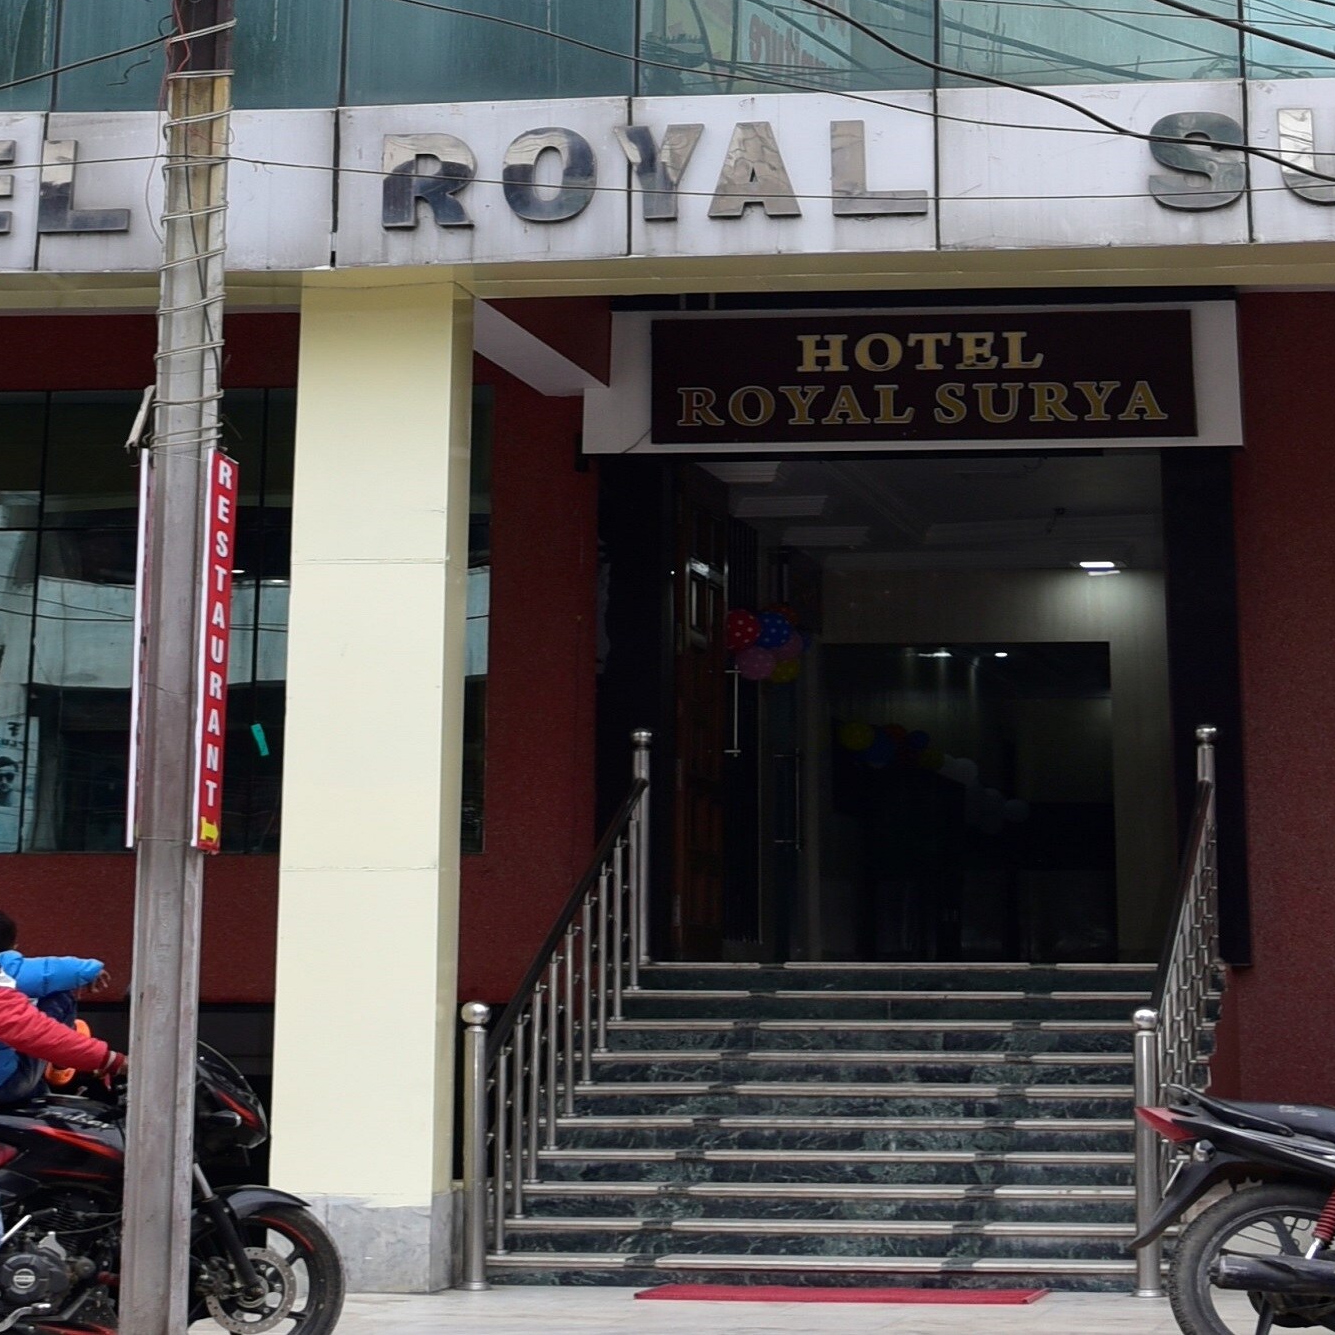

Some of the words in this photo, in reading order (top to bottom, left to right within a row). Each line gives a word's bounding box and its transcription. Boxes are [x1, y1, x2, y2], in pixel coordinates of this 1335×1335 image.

[381, 119, 929, 230] ROYAL
[796, 330, 1045, 372] HOTEL
[677, 384, 915, 427] ROYAL
[934, 380, 1169, 424] SURYA
[204, 458, 234, 808] RESTAURANT
